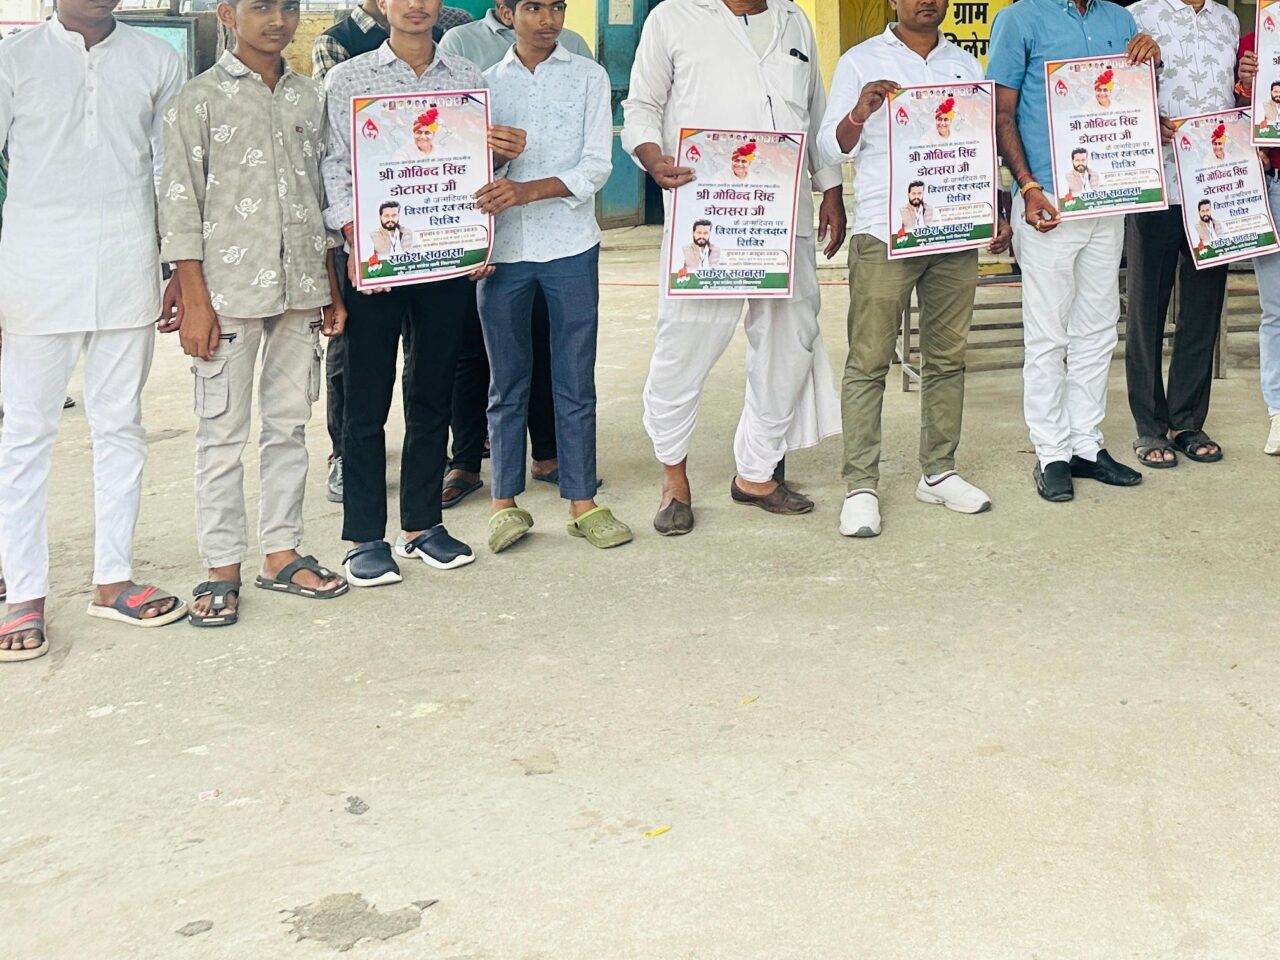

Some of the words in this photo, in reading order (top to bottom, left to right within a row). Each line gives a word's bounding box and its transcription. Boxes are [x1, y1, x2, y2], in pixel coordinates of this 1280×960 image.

[953, 2, 989, 24] ग्राम
[379, 166, 394, 180] श्री
[397, 164, 439, 179] गोविन्द
[390, 184, 438, 196] डोटासरा
[441, 181, 457, 194] जी
[696, 188, 710, 200] श्री
[751, 206, 765, 216] जी
